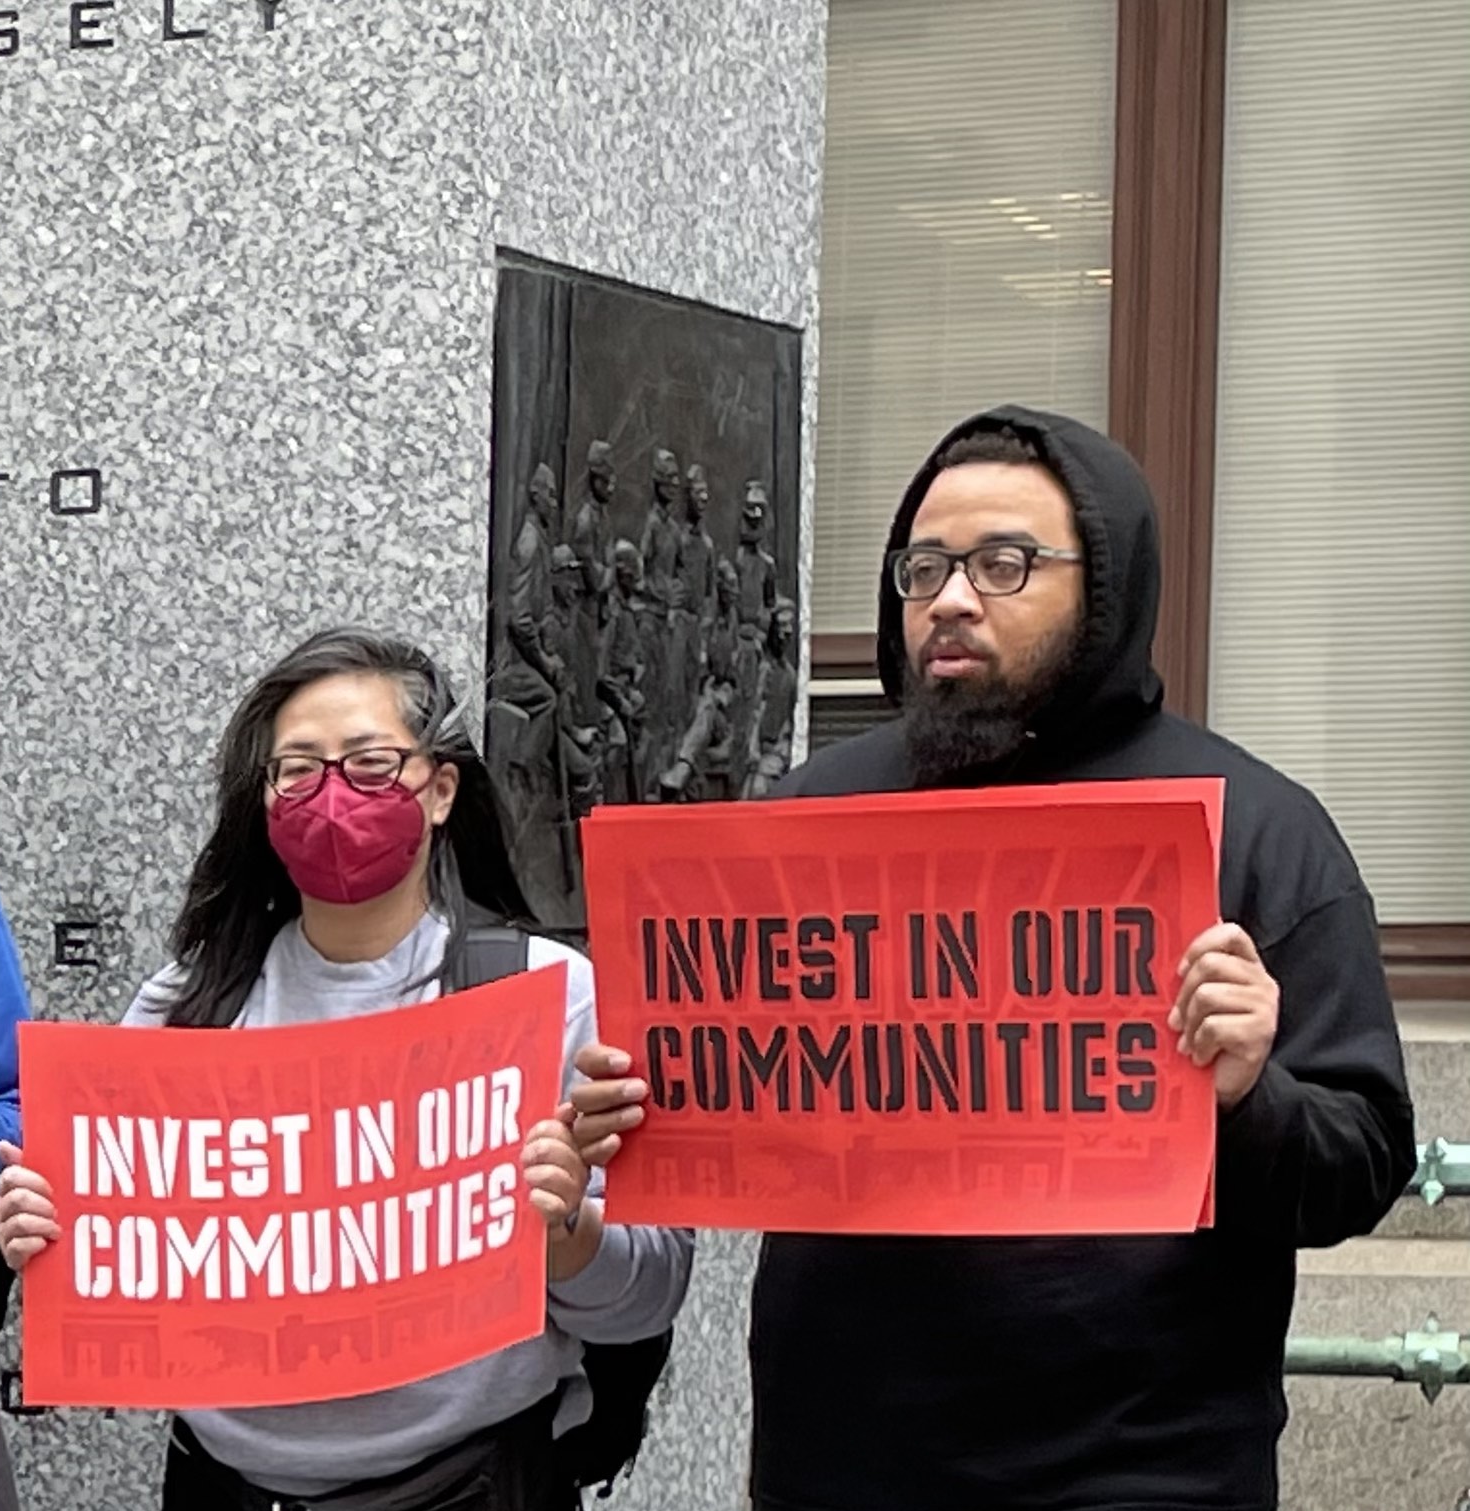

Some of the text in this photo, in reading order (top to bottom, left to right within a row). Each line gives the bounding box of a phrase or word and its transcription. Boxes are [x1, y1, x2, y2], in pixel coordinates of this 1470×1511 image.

[641, 905, 1156, 1002] INVEST IN OUR
[645, 1021, 1158, 1114] COMMUNITIES
[71, 1065, 523, 1199] INVEST IN OUR
[72, 1161, 518, 1300] COMMUNITIES
